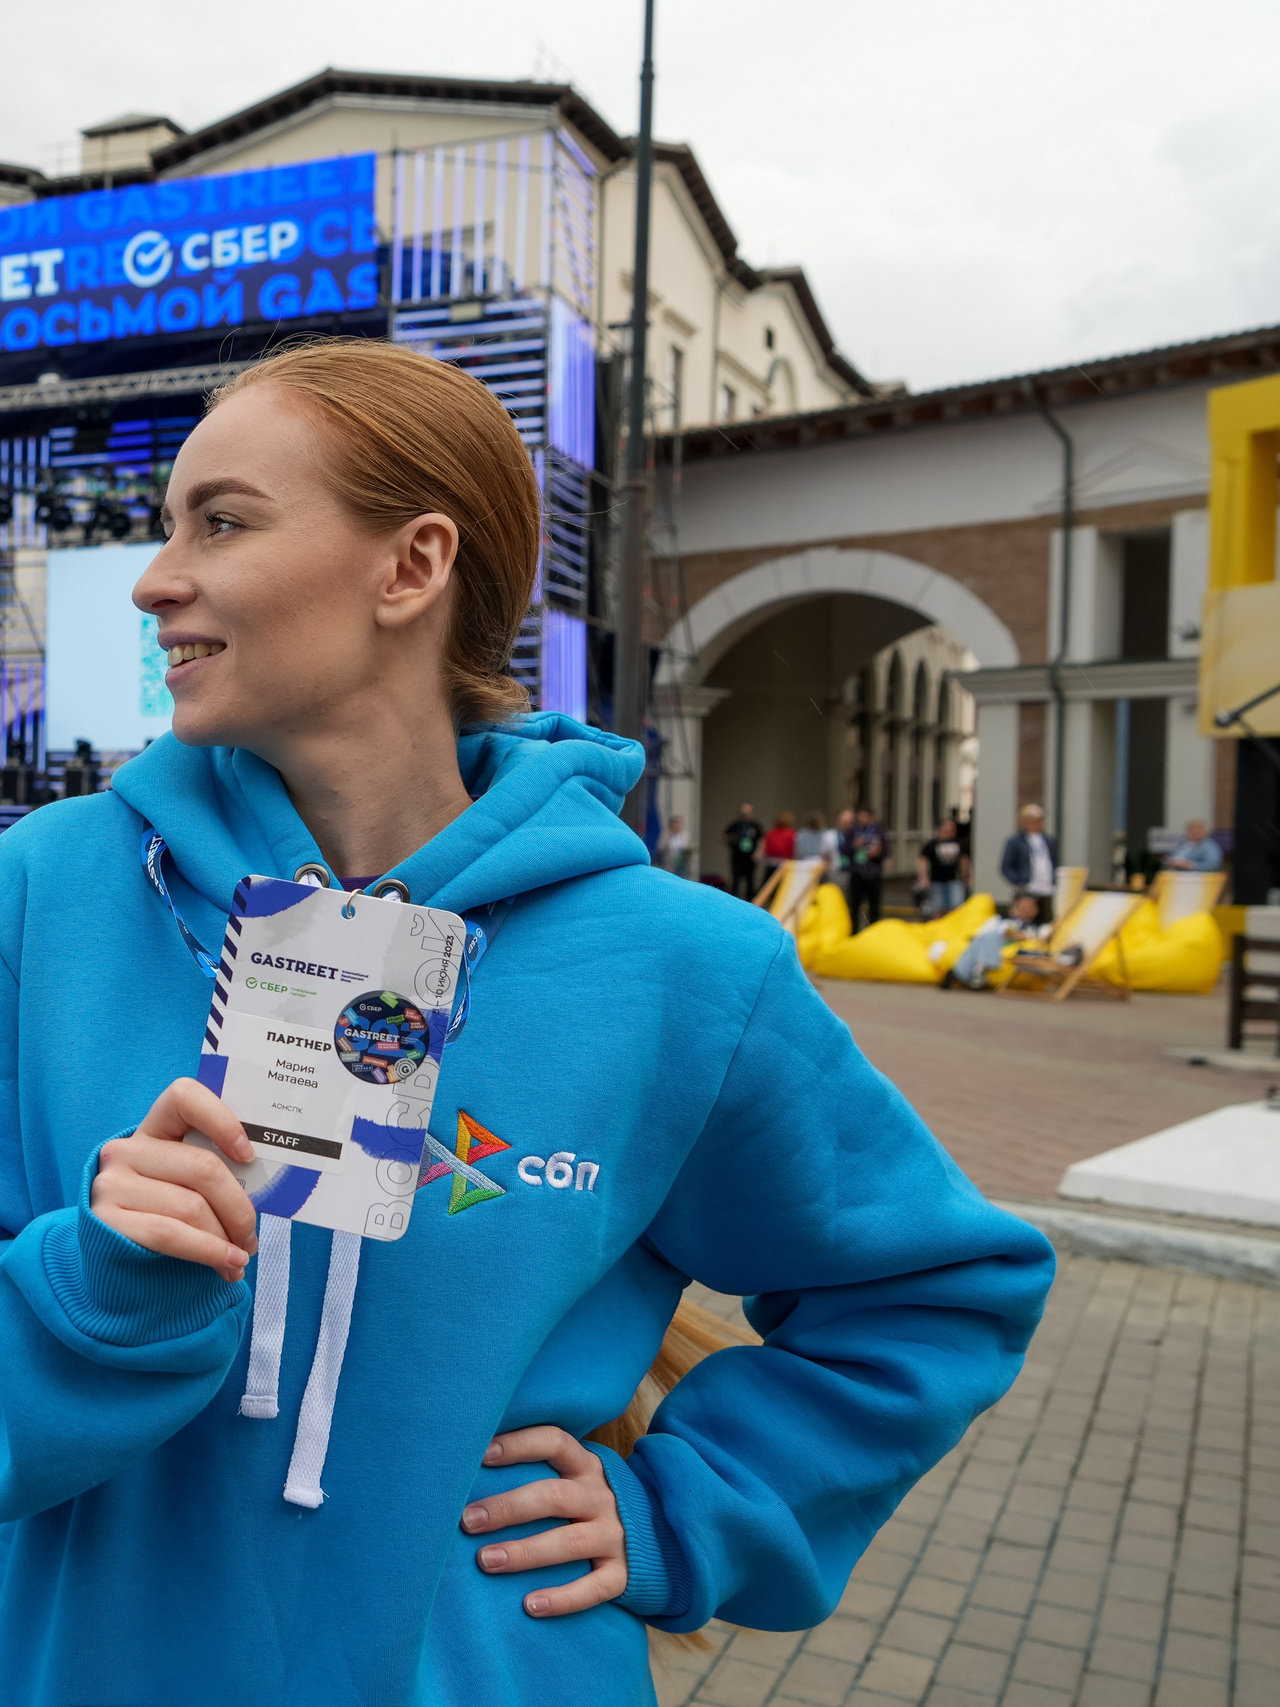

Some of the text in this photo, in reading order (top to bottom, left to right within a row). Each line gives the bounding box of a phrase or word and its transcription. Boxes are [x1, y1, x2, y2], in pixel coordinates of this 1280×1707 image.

[181, 220, 299, 271] СБЕР
[443, 935, 455, 958] 2023
[250, 952, 339, 980] GASTREET
[438, 959, 449, 988] ИЮНЯ
[260, 981, 288, 993] СБЕР
[435, 988, 444, 999] 10
[266, 1031, 332, 1052] ПАРТНЕР
[344, 1028, 400, 1043] GASTREET
[275, 1058, 315, 1075] Мария
[267, 1070, 319, 1089] Матаева
[263, 1131, 300, 1147] STAFF
[517, 1151, 599, 1191] сбп
